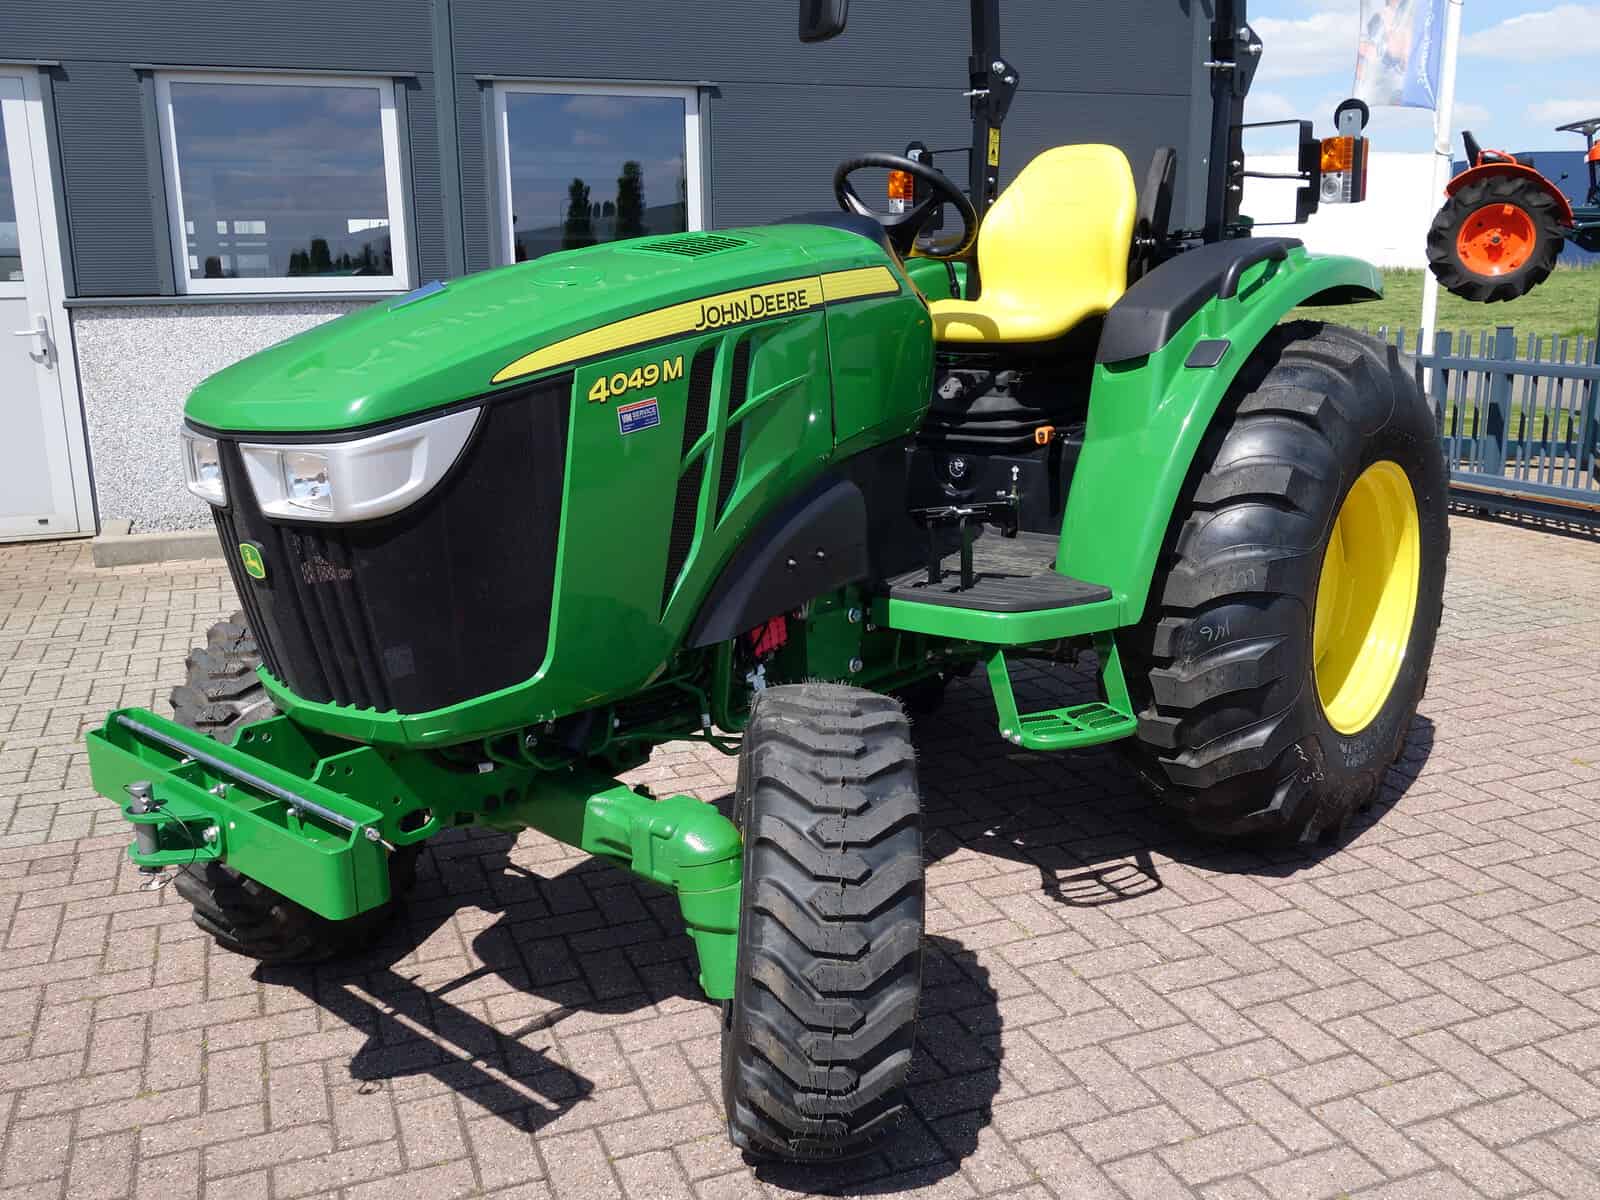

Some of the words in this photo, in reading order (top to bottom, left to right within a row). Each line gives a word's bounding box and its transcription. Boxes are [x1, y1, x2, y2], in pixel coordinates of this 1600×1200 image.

[695, 300, 749, 328] JOHN
[750, 289, 808, 316] DEERE
[588, 364, 660, 403] 4049
[663, 355, 683, 382] M
